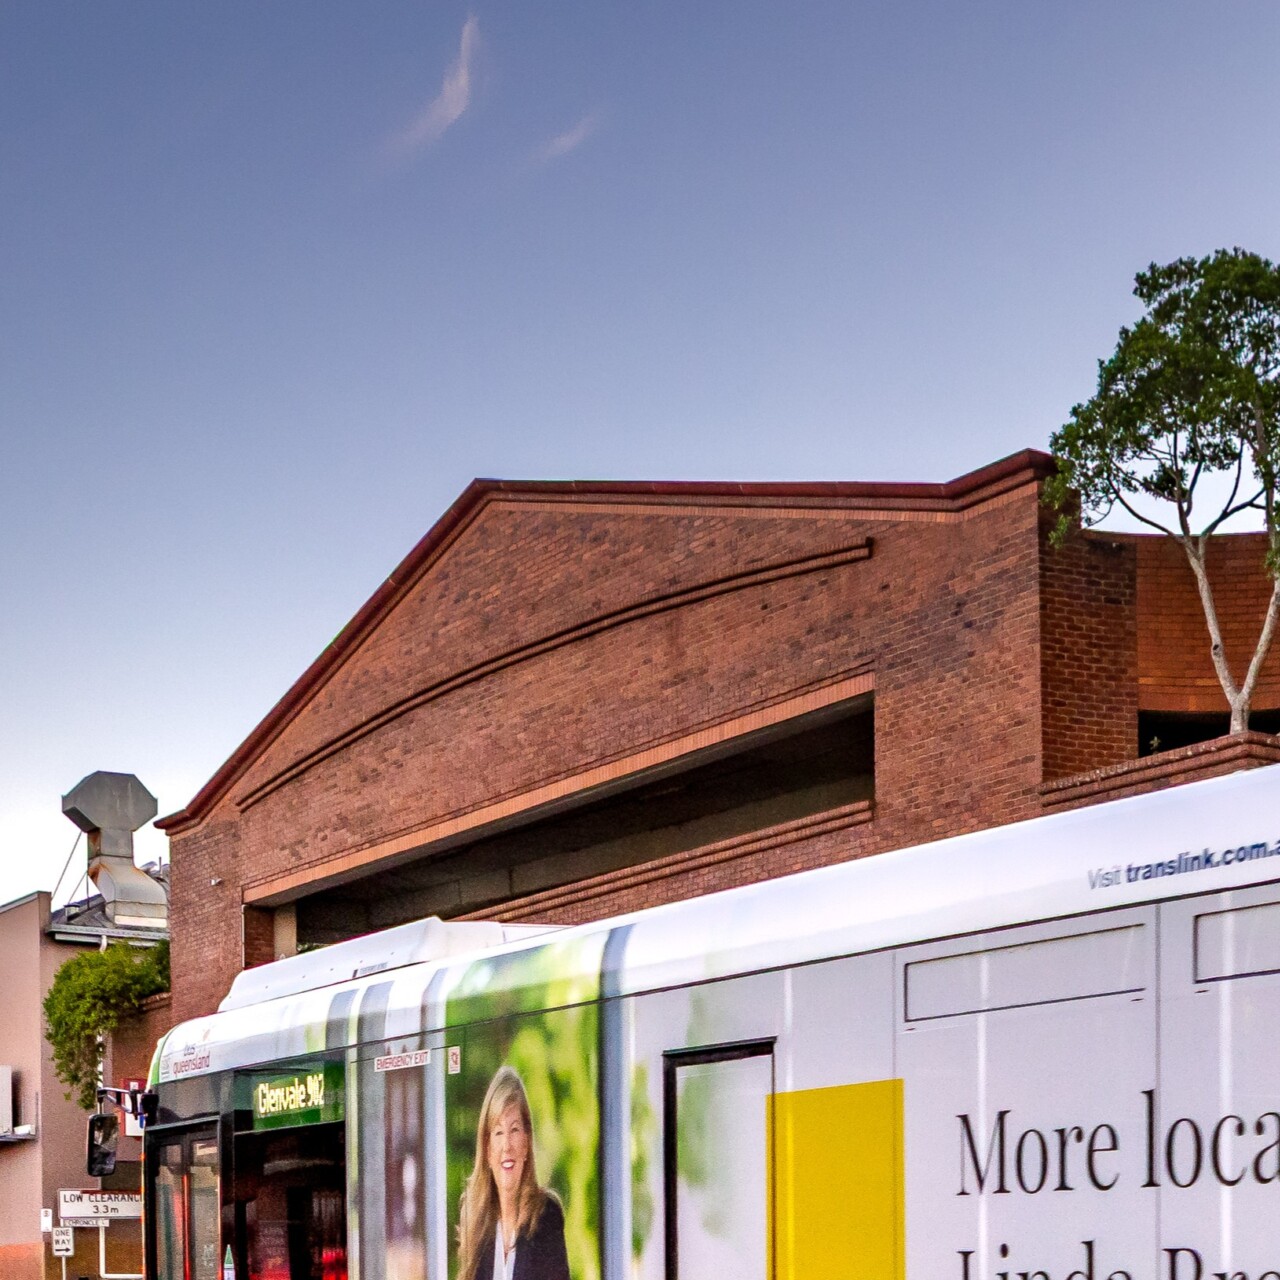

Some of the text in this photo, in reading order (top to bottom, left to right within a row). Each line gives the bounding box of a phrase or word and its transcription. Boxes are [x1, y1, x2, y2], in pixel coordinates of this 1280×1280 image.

[1087, 865, 1122, 890] Visit
[377, 1051, 428, 1070] EMERGENCY EXIT
[258, 1078, 306, 1114] Glenvale
[955, 1110, 1120, 1196] More
[64, 1193, 143, 1203] LOW CLEARANC
